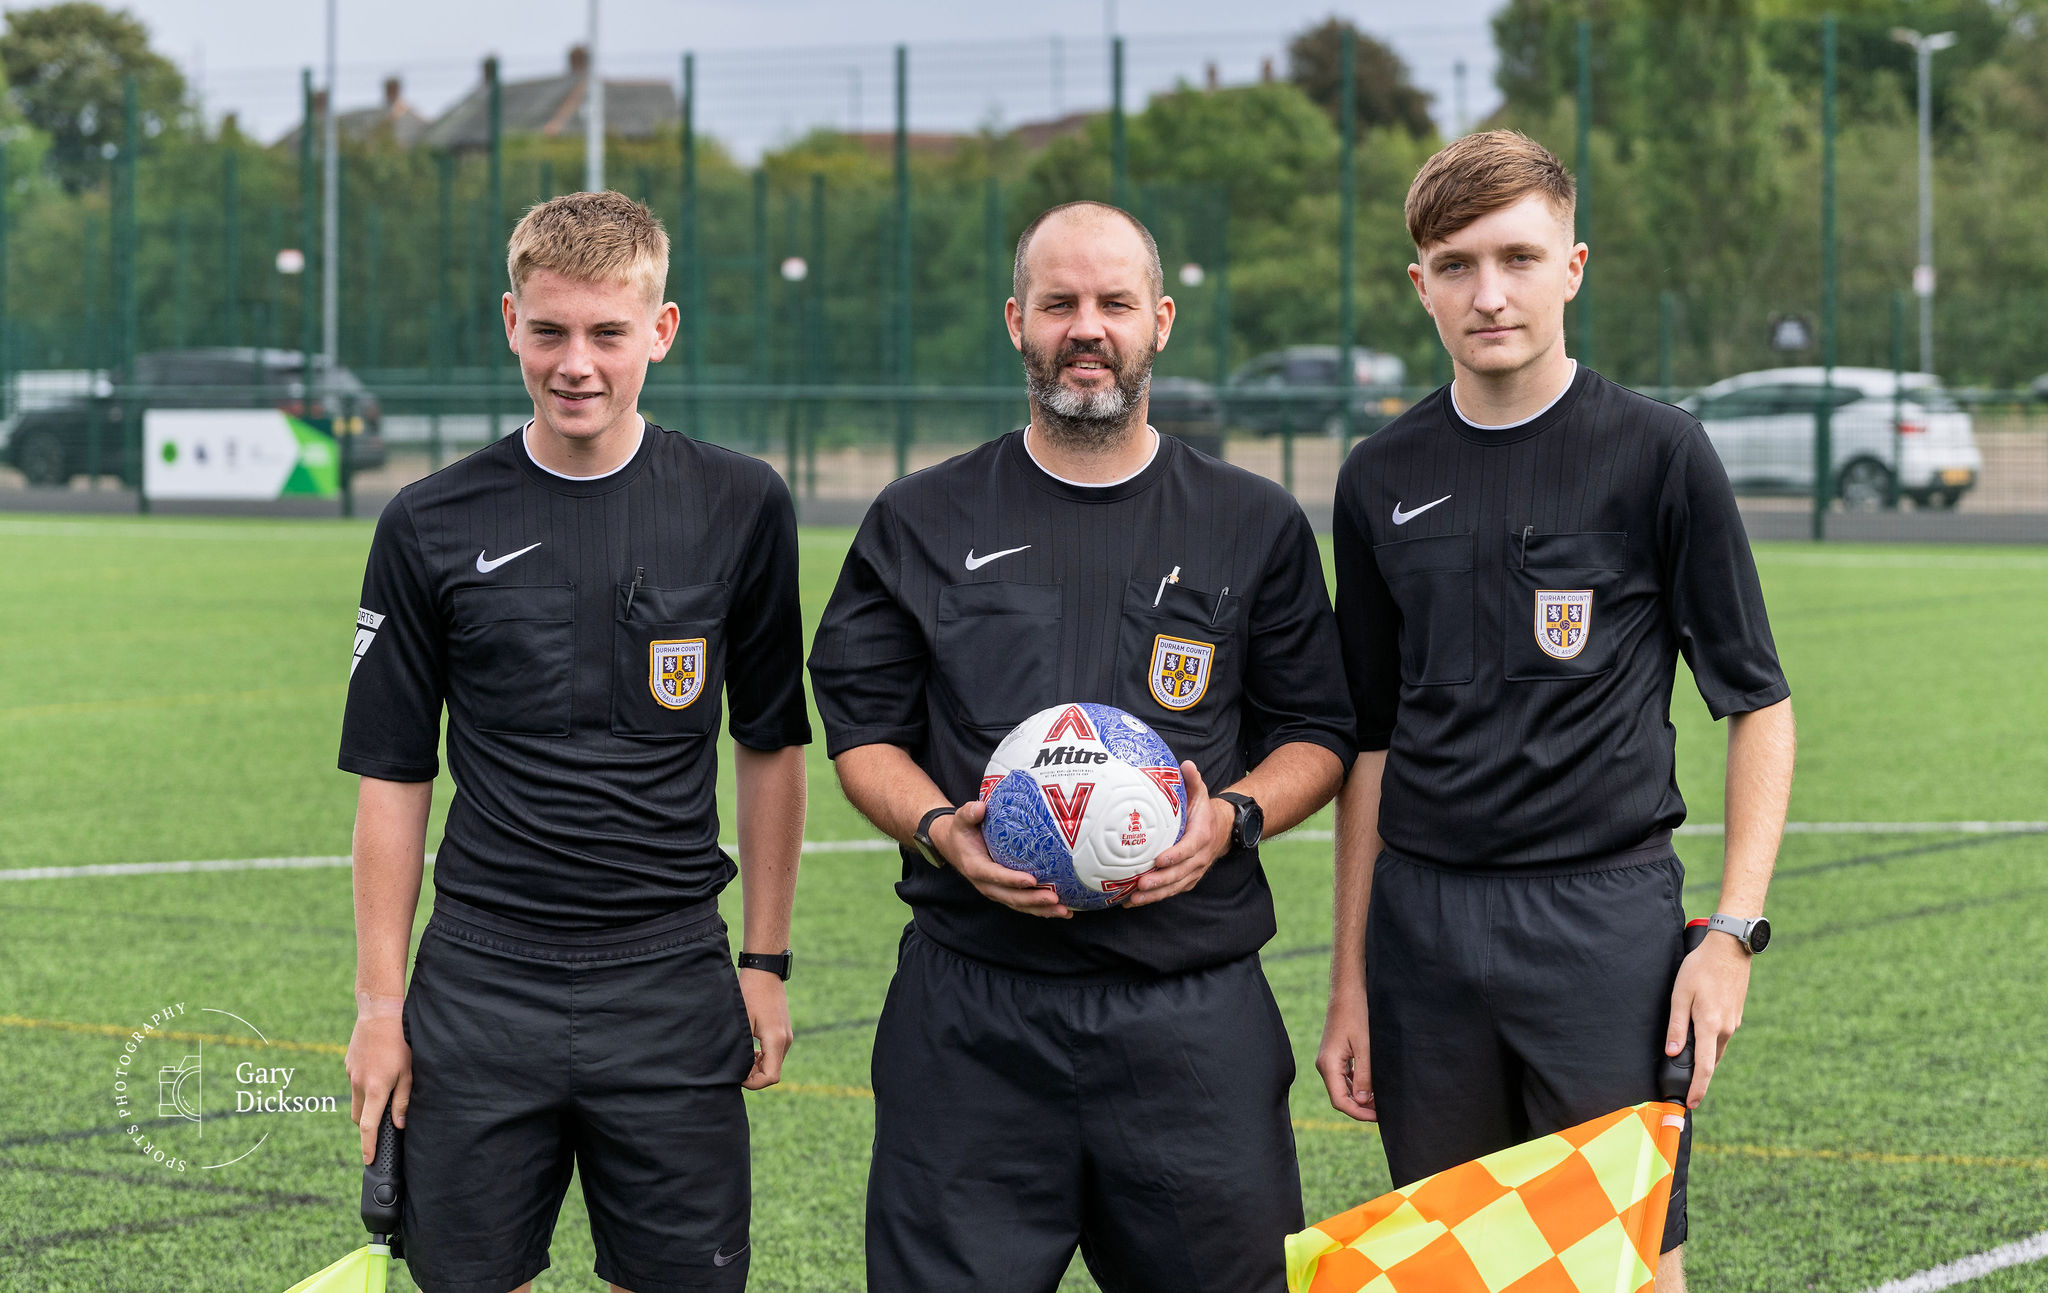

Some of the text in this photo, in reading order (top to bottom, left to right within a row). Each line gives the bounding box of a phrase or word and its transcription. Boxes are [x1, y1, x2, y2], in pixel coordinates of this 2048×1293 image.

[357, 610, 374, 625] ORTS
[655, 646, 680, 654] DURHAM
[1160, 641, 1210, 656] DURHAM COUNTY
[1540, 632, 1586, 655] FOOTBALL ASSOCIATION
[656, 681, 700, 704] FOOTBALL ASSOCIATION
[1154, 679, 1201, 705] FOOTBALL ASSOCIATION
[1030, 745, 1109, 770] Mitre
[1121, 837, 1147, 847] FA CUP
